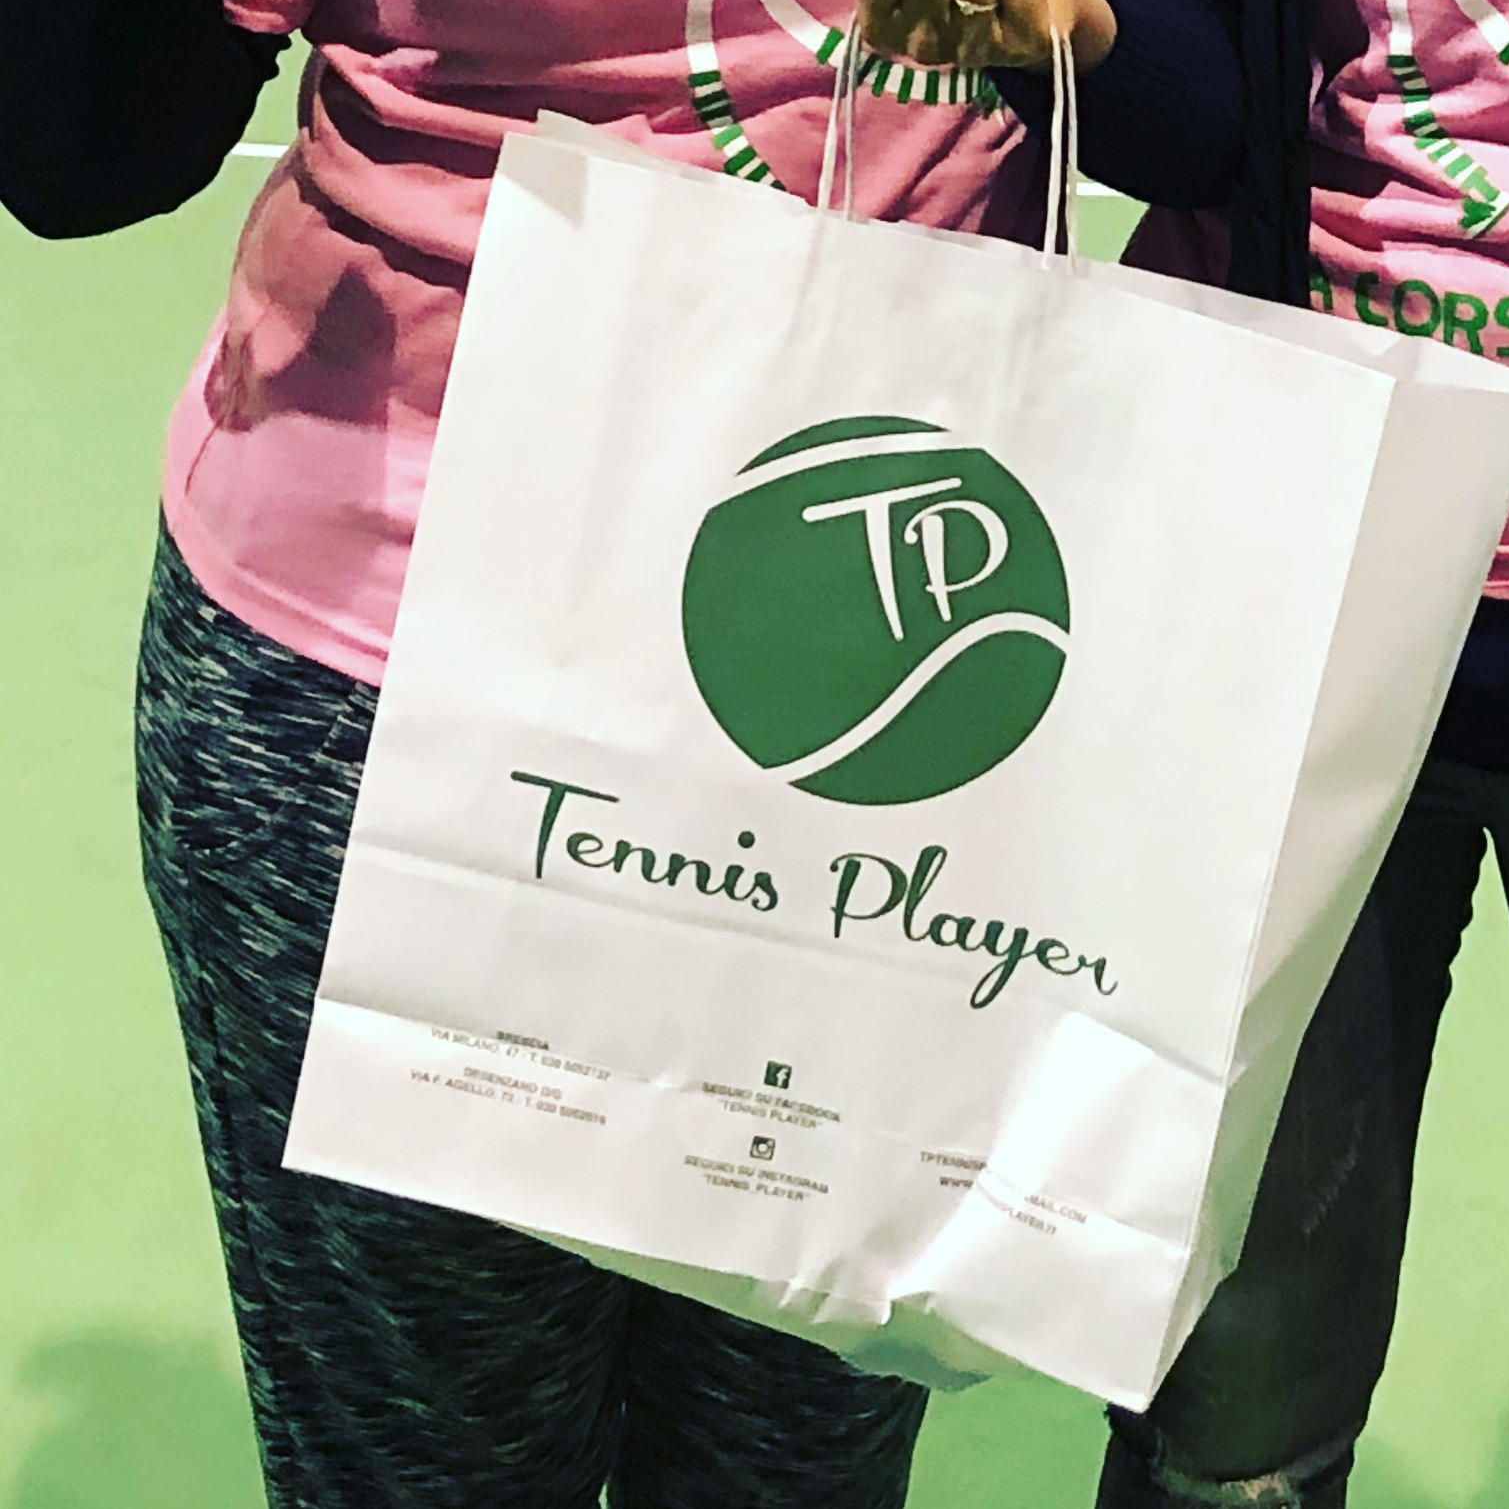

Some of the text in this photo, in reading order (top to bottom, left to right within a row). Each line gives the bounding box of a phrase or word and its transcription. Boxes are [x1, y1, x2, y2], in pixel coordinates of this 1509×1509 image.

[802, 477, 1010, 641] TP
[510, 770, 1119, 1010] Tennis Player
